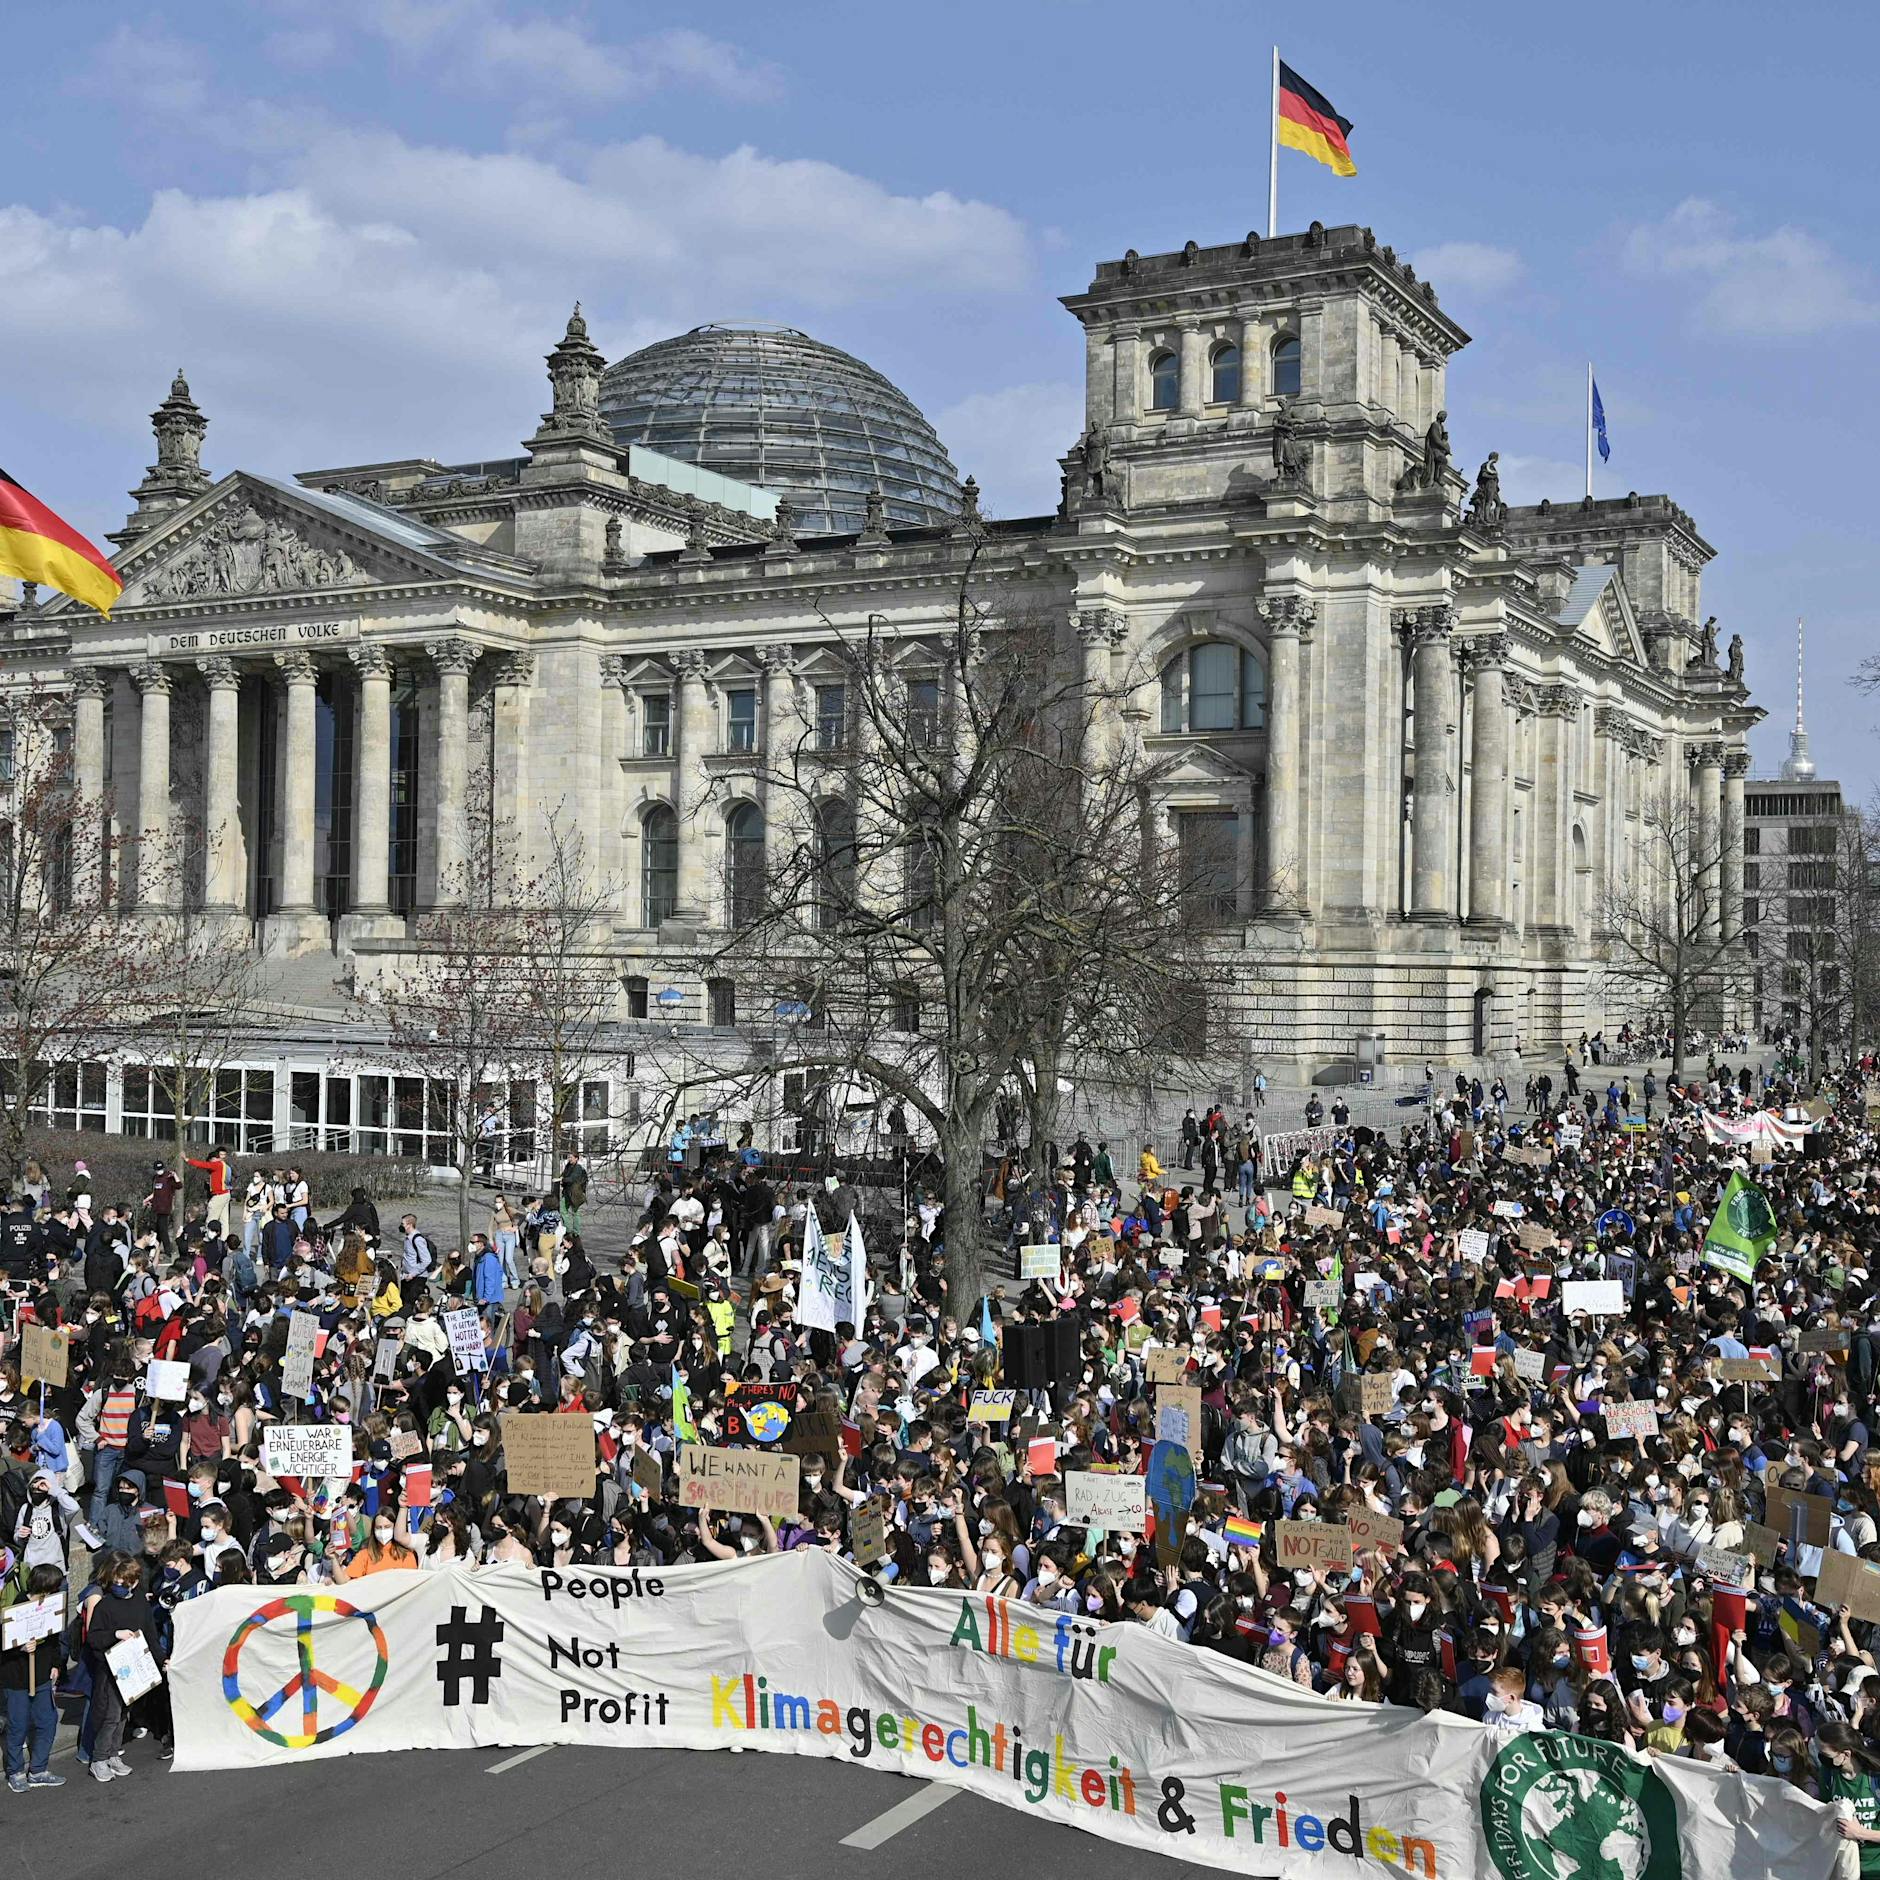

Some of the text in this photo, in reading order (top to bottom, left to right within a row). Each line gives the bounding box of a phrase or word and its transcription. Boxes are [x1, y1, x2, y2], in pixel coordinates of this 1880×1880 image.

[170, 623, 340, 649] DEM DEUTSCHEN VOLKE
[1730, 1189, 1759, 1207] FRIDAYS
[9, 1224, 32, 1232] POLIZEI
[460, 1309, 478, 1320] EARTH
[454, 1328, 479, 1342] HOTTER
[452, 1341, 482, 1353] THAN HARRY
[777, 1383, 798, 1401] NO
[972, 1390, 1015, 1404] FUCK
[271, 1427, 332, 1440] NIE WAR
[727, 1415, 741, 1436] B
[269, 1438, 342, 1453] ERNEUERBARE
[290, 1451, 329, 1463] ENERGIE
[689, 1451, 786, 1481] WE WANT A
[282, 1463, 338, 1475] WICHTIGER
[1074, 1487, 1093, 1502] RAD
[1103, 1488, 1127, 1503] ZUG
[1283, 1522, 1304, 1533] Our
[1309, 1523, 1333, 1534] Future
[1348, 1517, 1370, 1536] NO
[1283, 1534, 1325, 1558] NOT
[1318, 1544, 1349, 1561] SALE
[541, 1568, 665, 1609] People
[949, 1595, 1117, 1683] Alle für
[547, 1634, 620, 1669] Not
[560, 1689, 670, 1725] Profit
[709, 1673, 1438, 1880] Klimagerechtigkeit & Frieden
[1490, 1736, 1628, 1880] FRIDAYS FOR FUTURE
